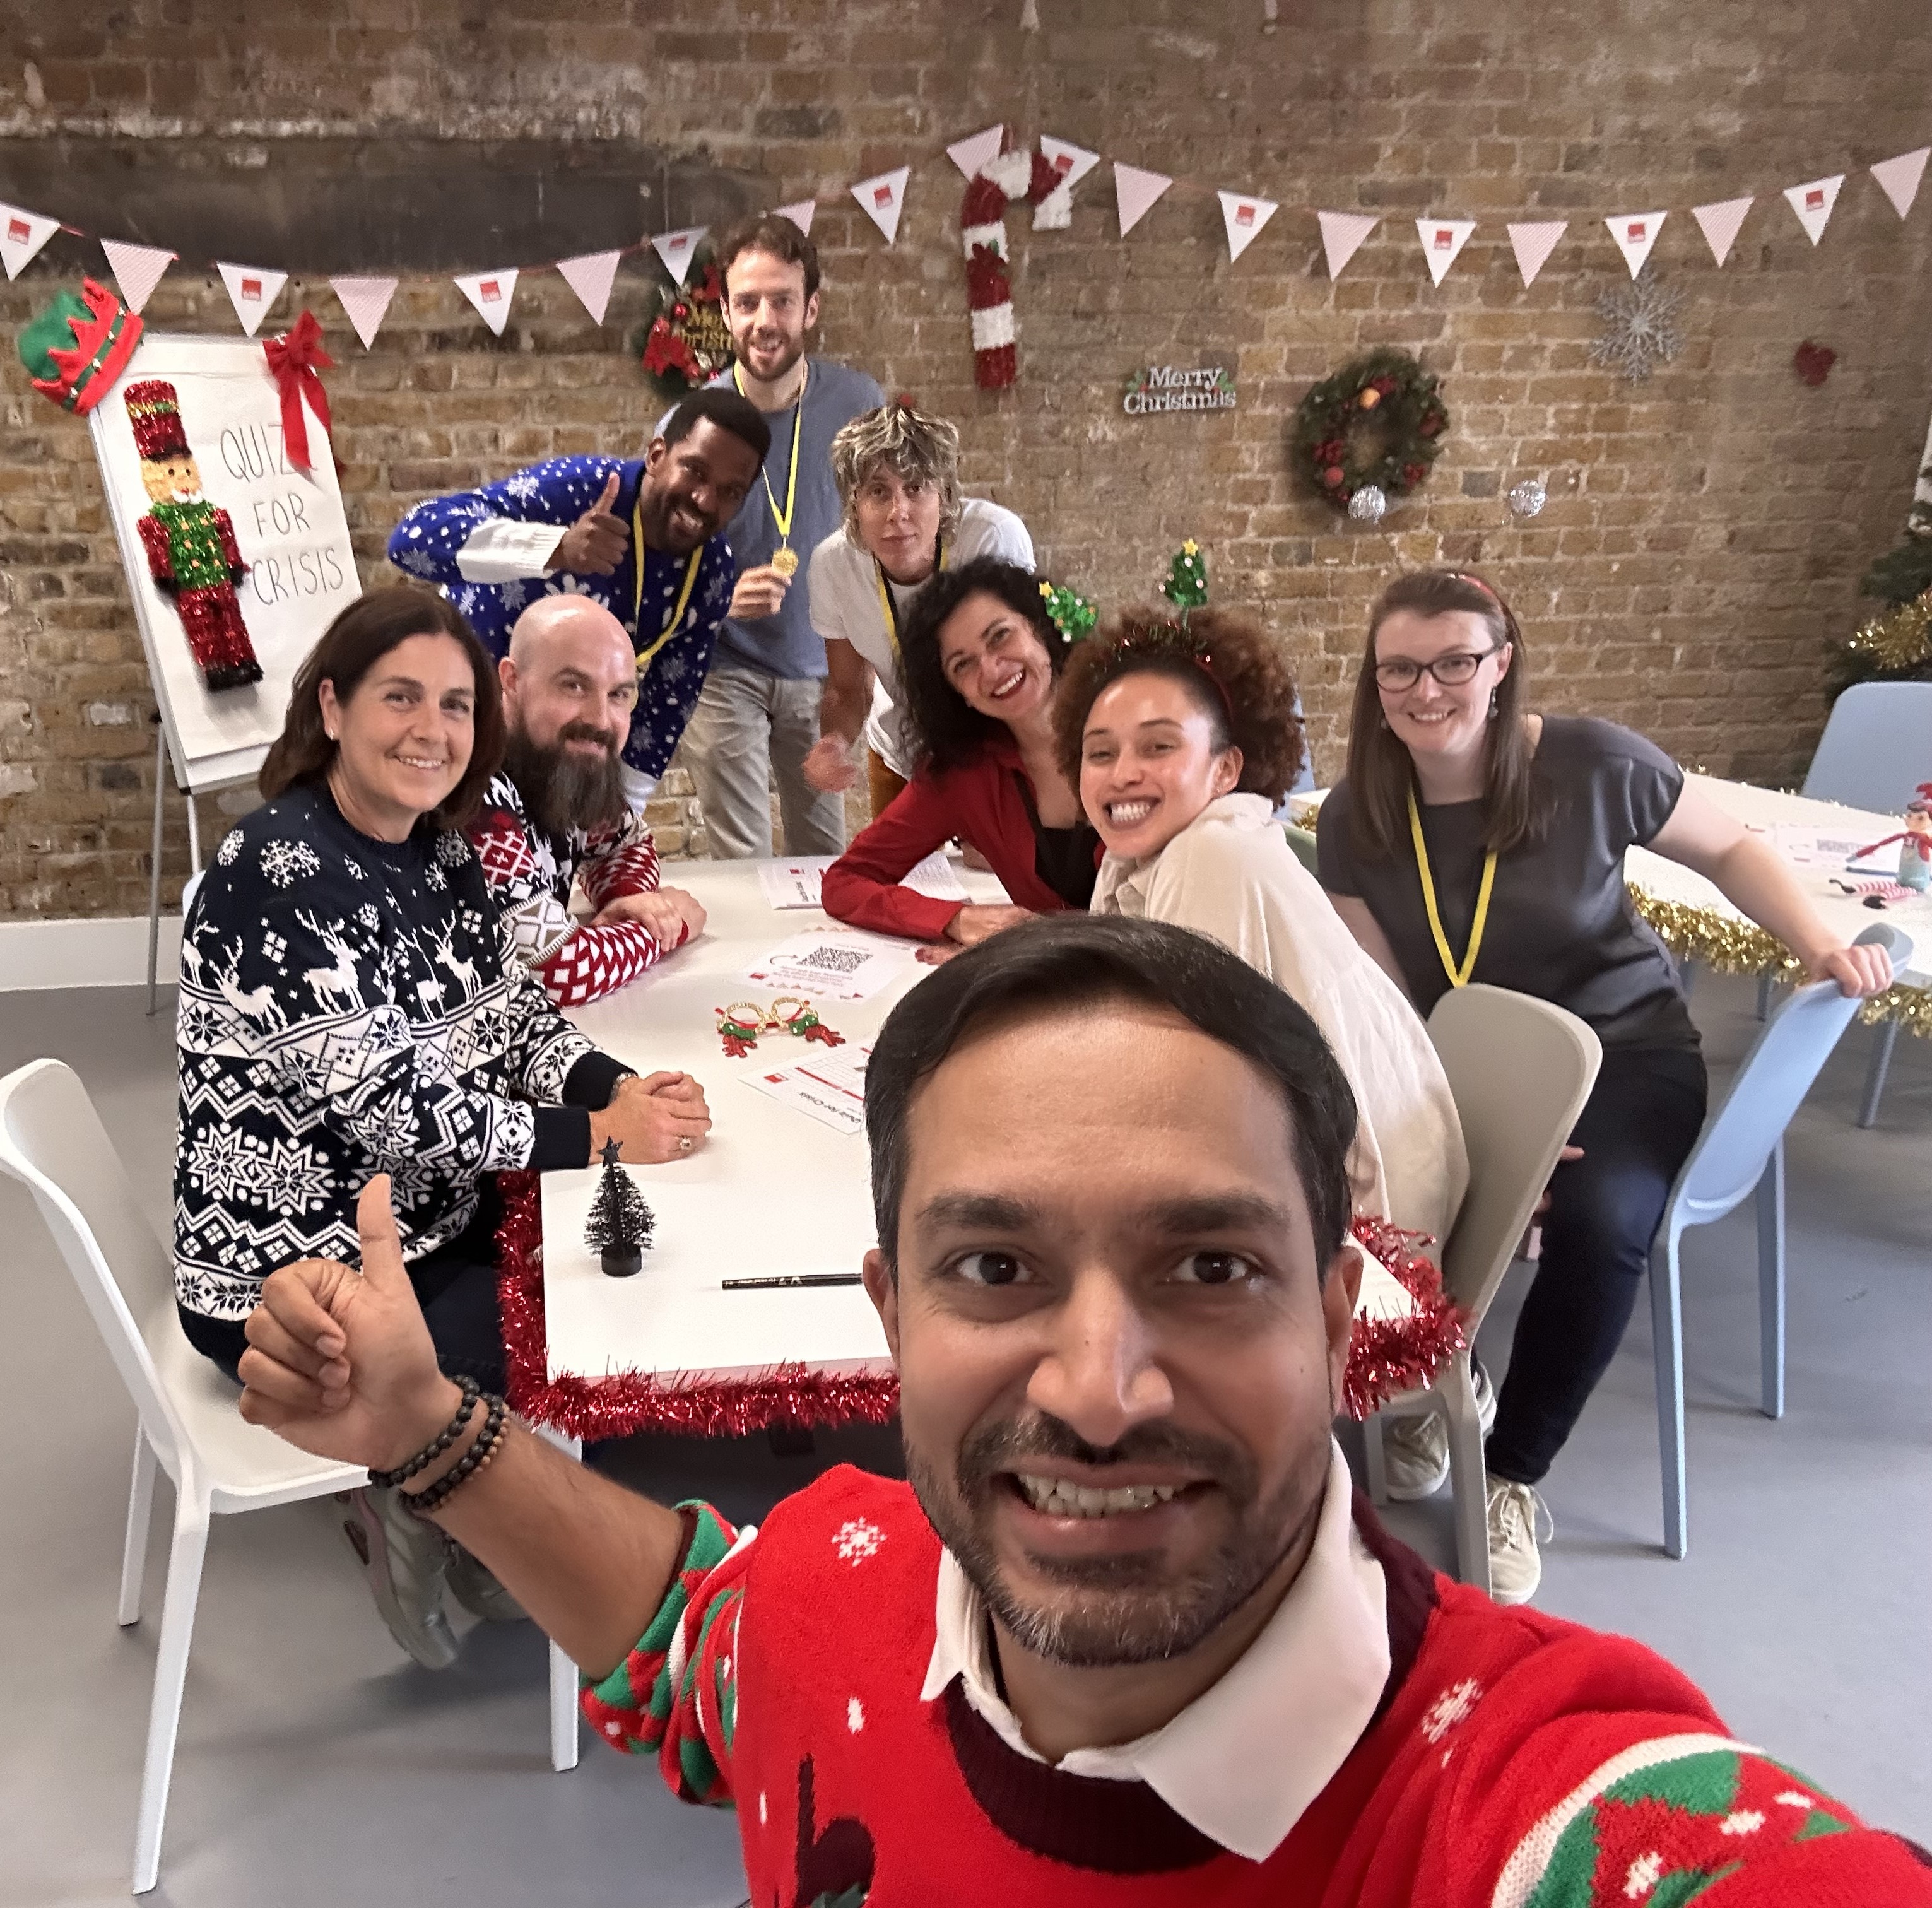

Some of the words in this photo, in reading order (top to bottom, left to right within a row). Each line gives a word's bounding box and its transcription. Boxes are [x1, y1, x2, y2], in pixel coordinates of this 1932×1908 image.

[1150, 365, 1222, 391] Merry
[1124, 391, 1236, 414] Christmas
[254, 492, 310, 538] FOR
[252, 548, 343, 605] CRISIS
